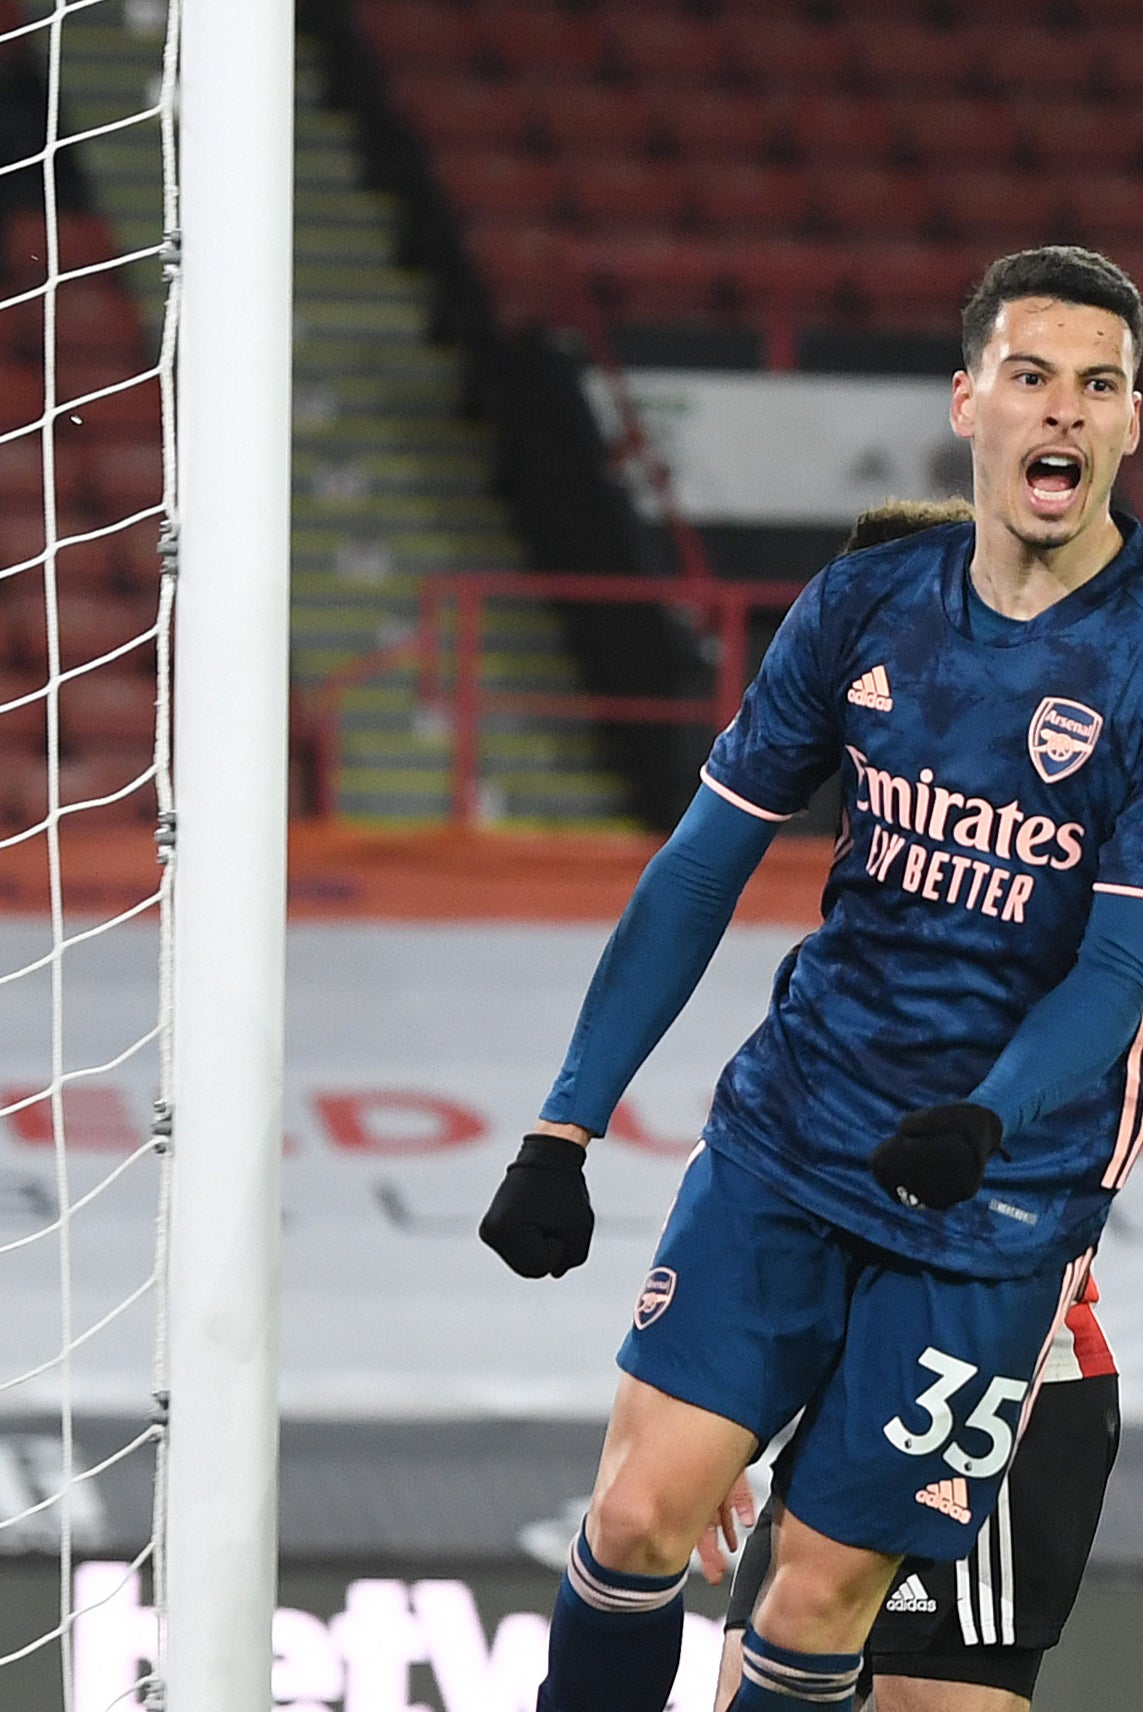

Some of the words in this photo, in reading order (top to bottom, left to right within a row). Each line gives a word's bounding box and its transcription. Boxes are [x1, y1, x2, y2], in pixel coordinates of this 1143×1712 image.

[847, 688, 894, 713] adidas
[1045, 709, 1093, 737] Arsenal
[902, 843, 1034, 924] BETTER
[882, 1346, 1029, 1478] 35
[914, 1489, 972, 1525] adidas
[885, 1598, 937, 1613] adidas
